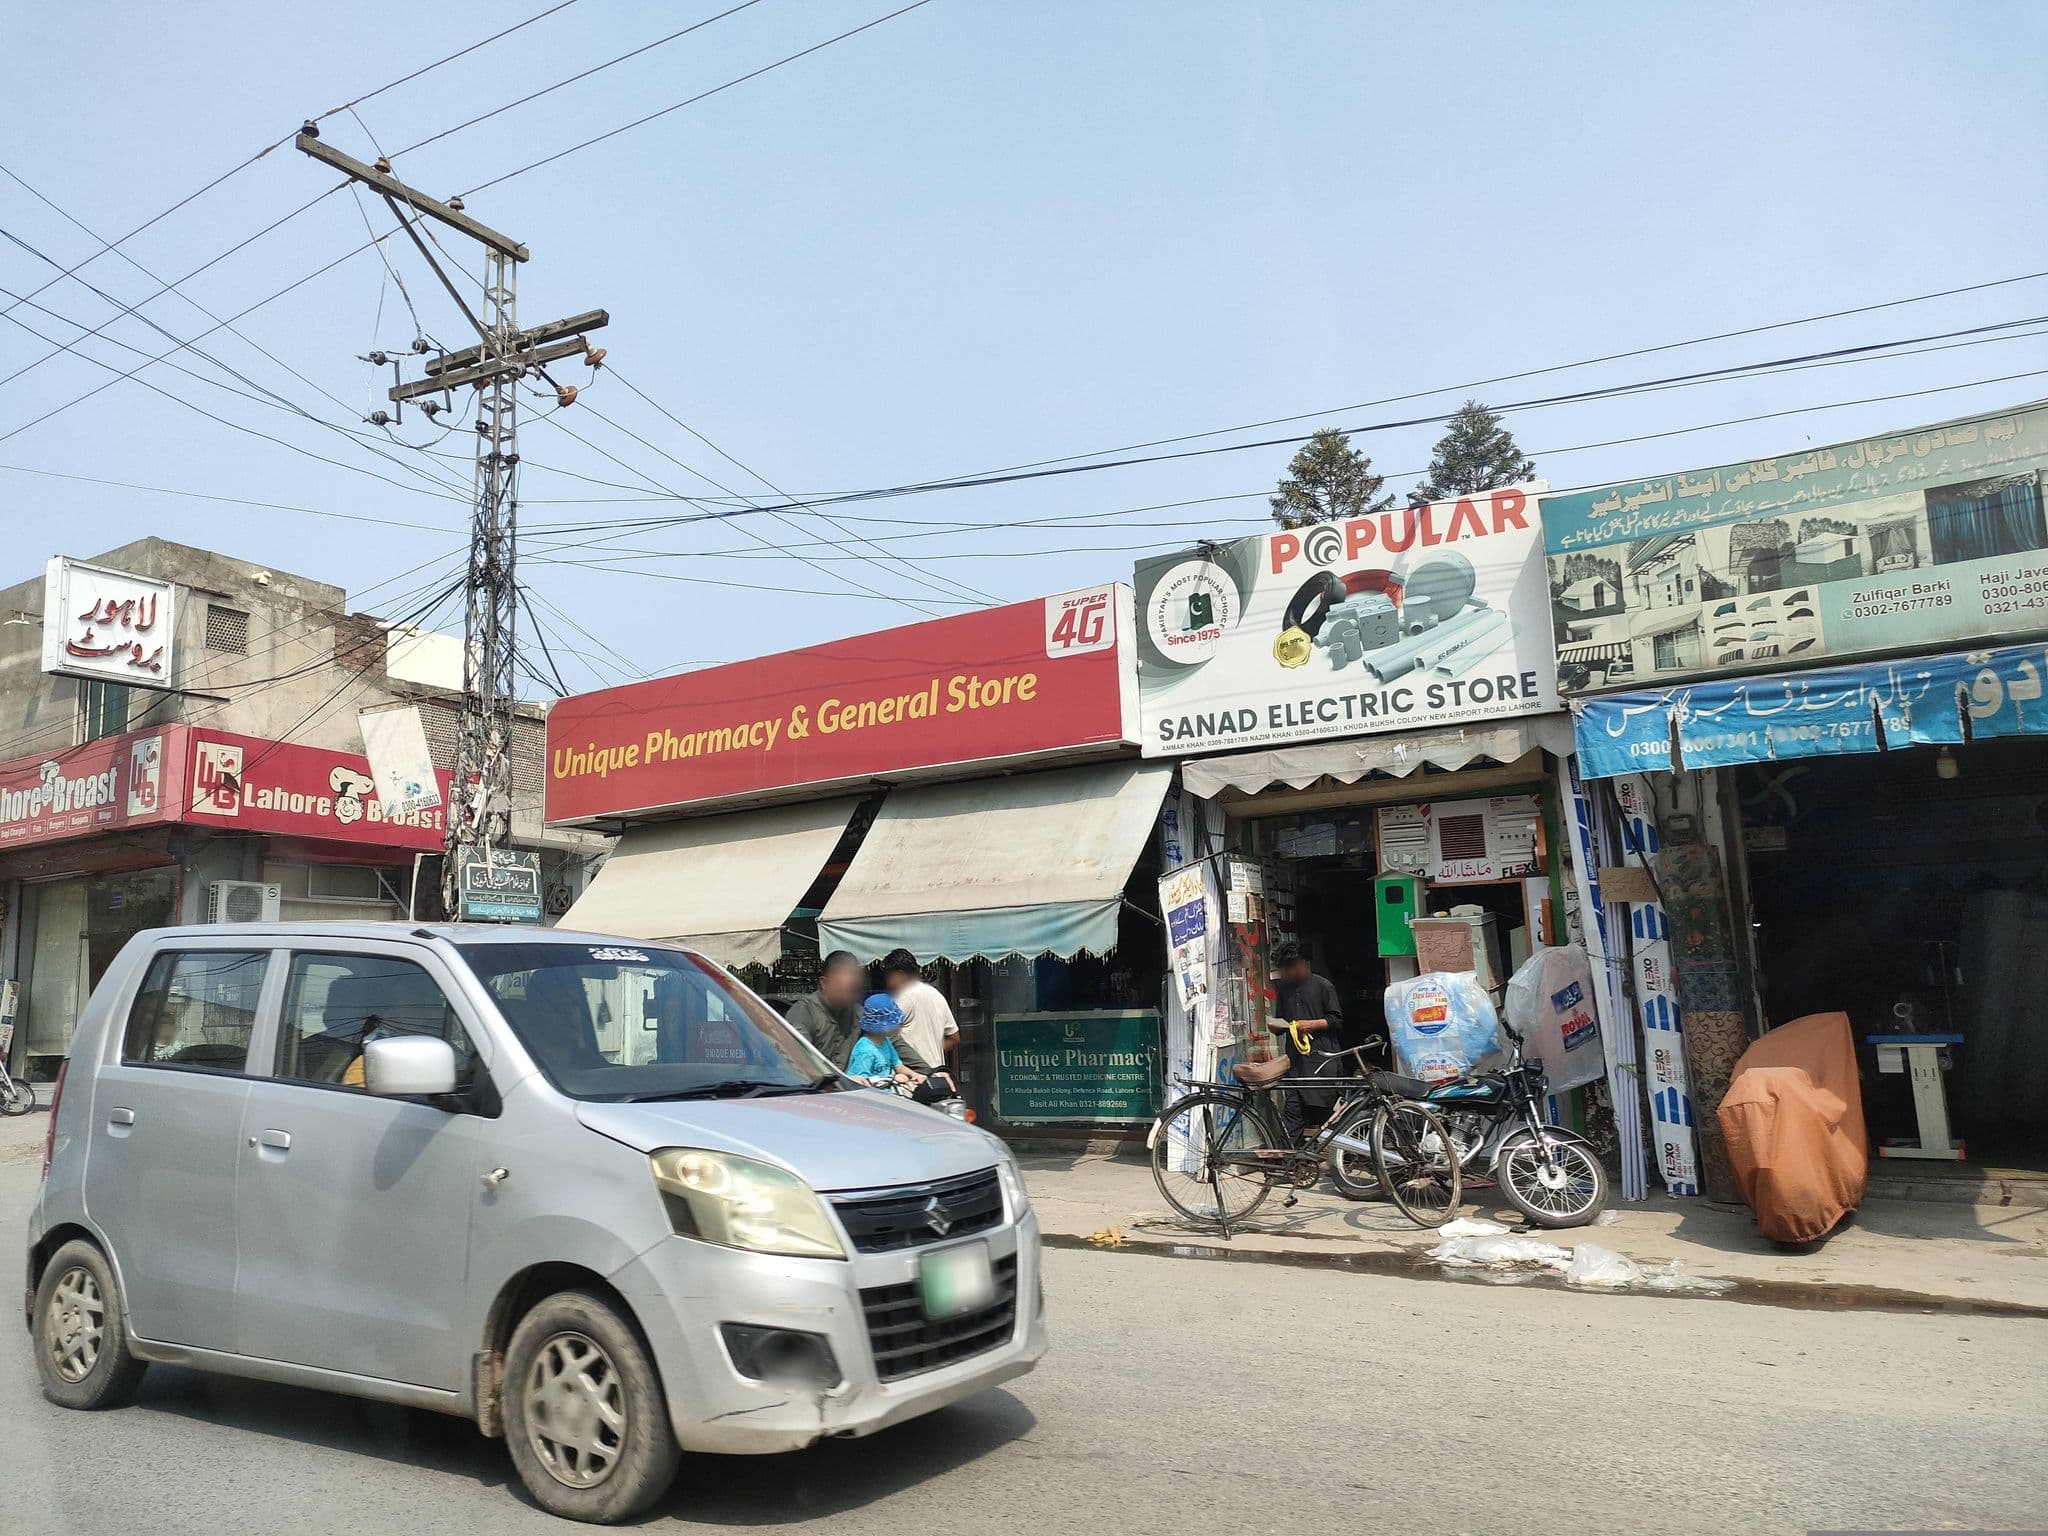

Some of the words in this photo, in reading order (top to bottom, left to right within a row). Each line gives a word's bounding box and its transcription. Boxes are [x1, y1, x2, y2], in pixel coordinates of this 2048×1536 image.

[1271, 488, 1529, 574] POPULAR
[1170, 575, 1191, 591] MOST
[1193, 574, 1224, 596] POPULAR
[1853, 587, 1908, 604] Zulfiqar
[1912, 579, 1951, 595] Barki
[1980, 571, 2010, 586] Haji
[79, 592, 157, 632] لاہور
[1062, 592, 1108, 609] SUPER
[1855, 594, 1953, 618] 0302-7677789
[1984, 596, 2048, 616] 0321-43
[1051, 602, 1106, 648] 4G
[1168, 633, 1196, 646] Since
[1197, 628, 1221, 642] 1975
[1159, 708, 1258, 742] SANAD
[1268, 687, 1414, 729] ELECTRIC
[1426, 671, 1539, 710] STORE
[1250, 733, 1270, 742] NAZIM
[1272, 730, 1293, 740] KHAN:
[1344, 721, 1369, 731] KHUDA
[1370, 718, 1394, 728] BUKSH
[1397, 715, 1428, 725] COLONY
[1429, 711, 1447, 721] NEW
[1448, 708, 1482, 719] AIRPORT
[1484, 704, 1506, 714] ROAD
[1508, 701, 1542, 712] LAHORE
[553, 742, 640, 780] Unique
[644, 714, 783, 765] Pharmacy
[787, 705, 810, 740] &
[817, 678, 939, 735] General
[945, 673, 1037, 714] Store
[53, 767, 118, 814] Broast
[244, 782, 330, 818] Lahore
[366, 799, 443, 831] Boast
[1621, 783, 1632, 815] FLEXO
[1643, 958, 1656, 991] FLEXO
[1001, 1050, 1060, 1072] Unique
[1065, 1049, 1154, 1072] Pharmacy
[1052, 1073, 1082, 1081] TRUSTED
[1082, 1073, 1116, 1081] MEDICINE
[1117, 1073, 1145, 1081] CENTRE
[1655, 1049, 1667, 1083] FLEXO
[1664, 1142, 1677, 1177] FLEXO
